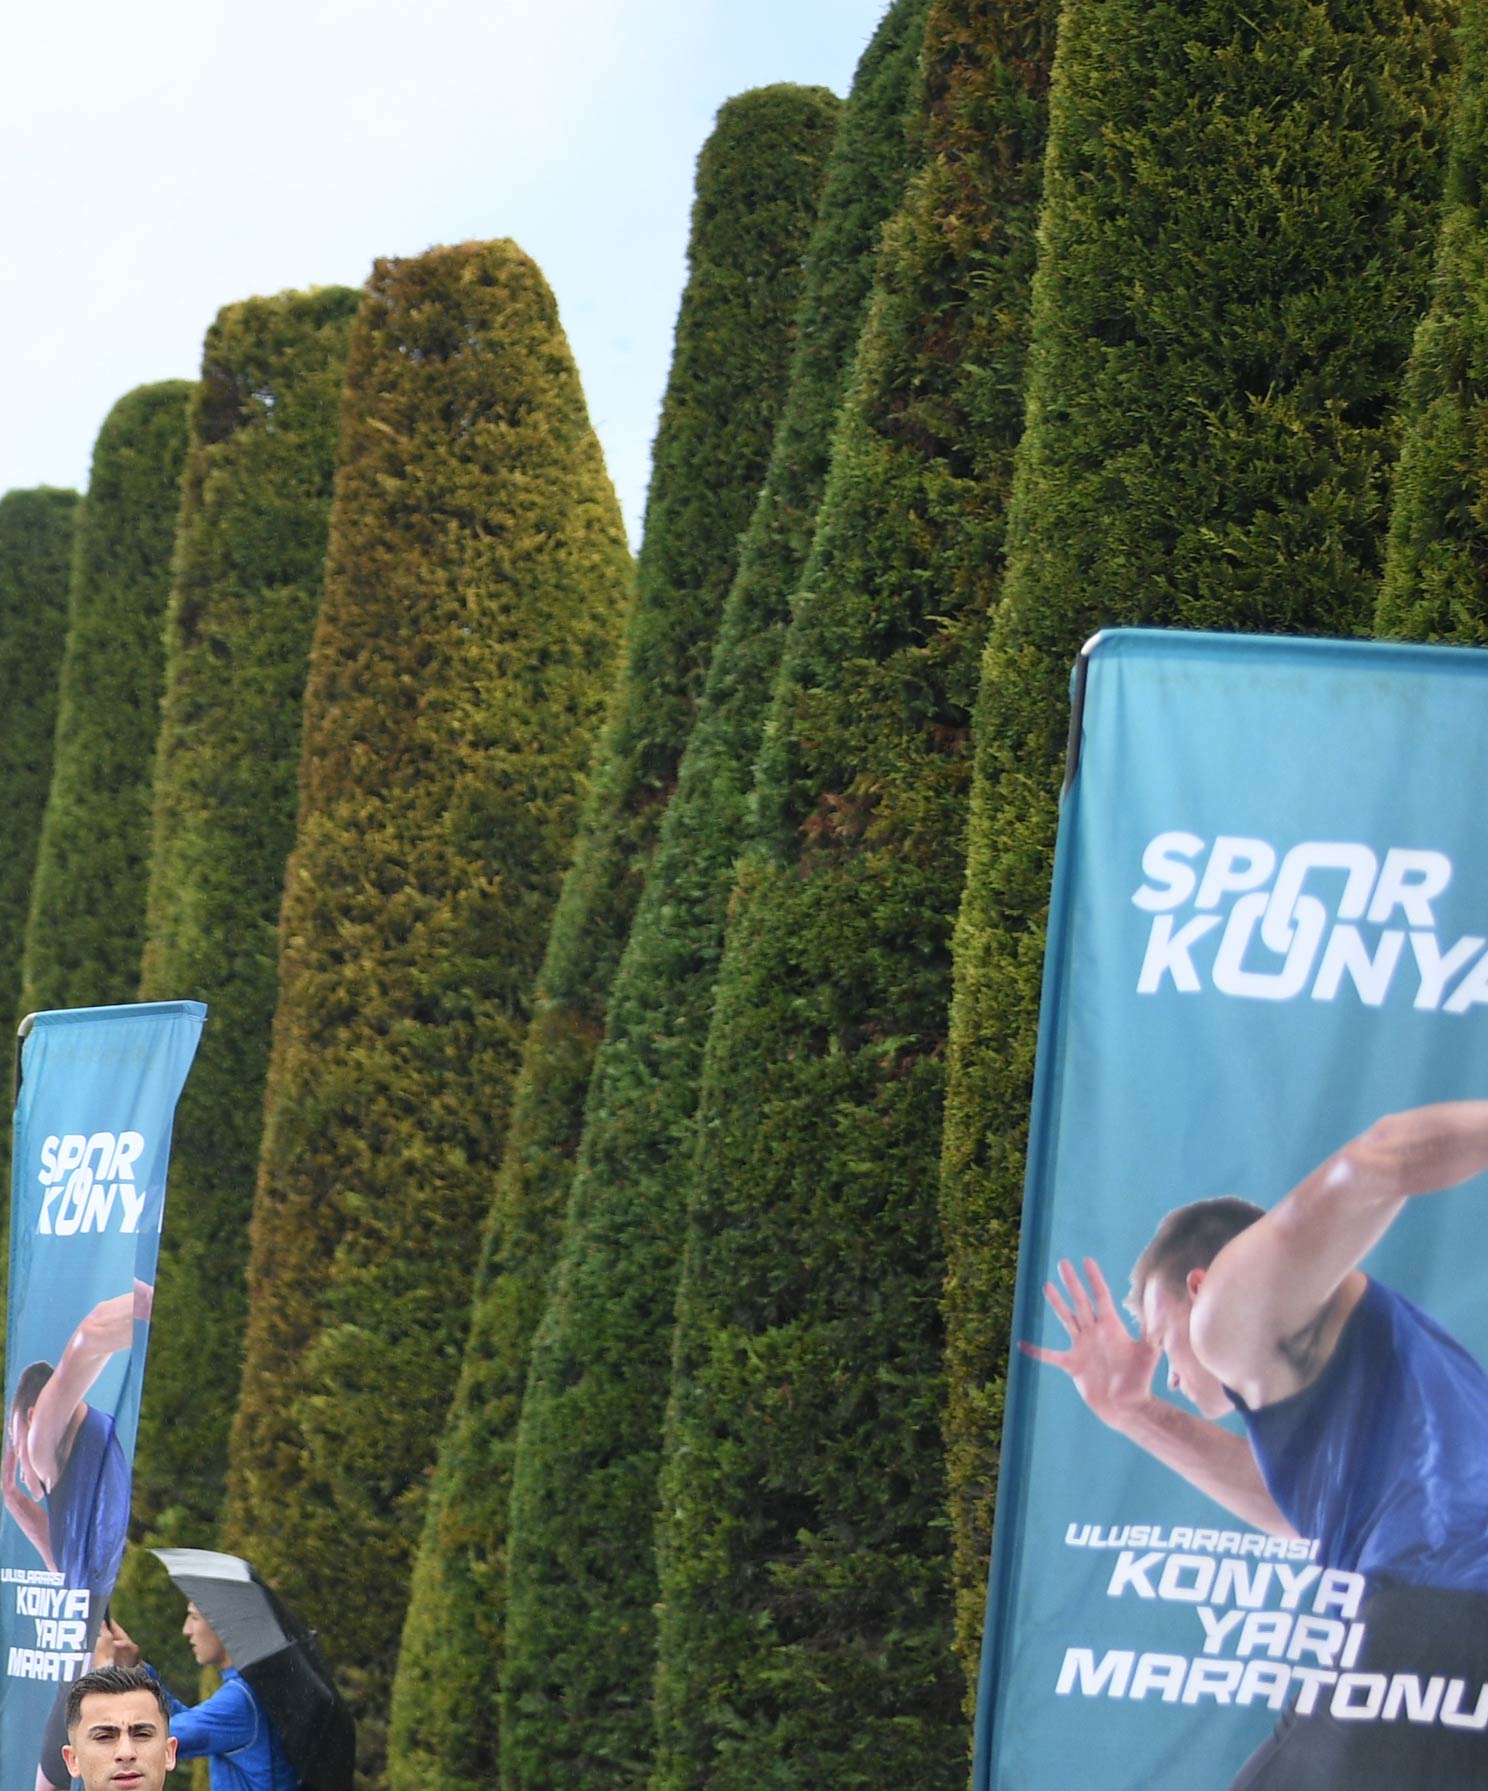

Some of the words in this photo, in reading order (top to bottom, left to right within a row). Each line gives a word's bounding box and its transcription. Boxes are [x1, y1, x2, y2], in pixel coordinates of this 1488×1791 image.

[1131, 831, 1452, 926] SPOR
[38, 1131, 144, 1185] SPOR
[37, 1183, 147, 1236] KONY
[1065, 1523, 1320, 1559] ULUSLARARASI
[1106, 1551, 1365, 1619] KONYA
[1196, 1605, 1366, 1669] YARI
[1055, 1648, 1488, 1710] MARATONU
